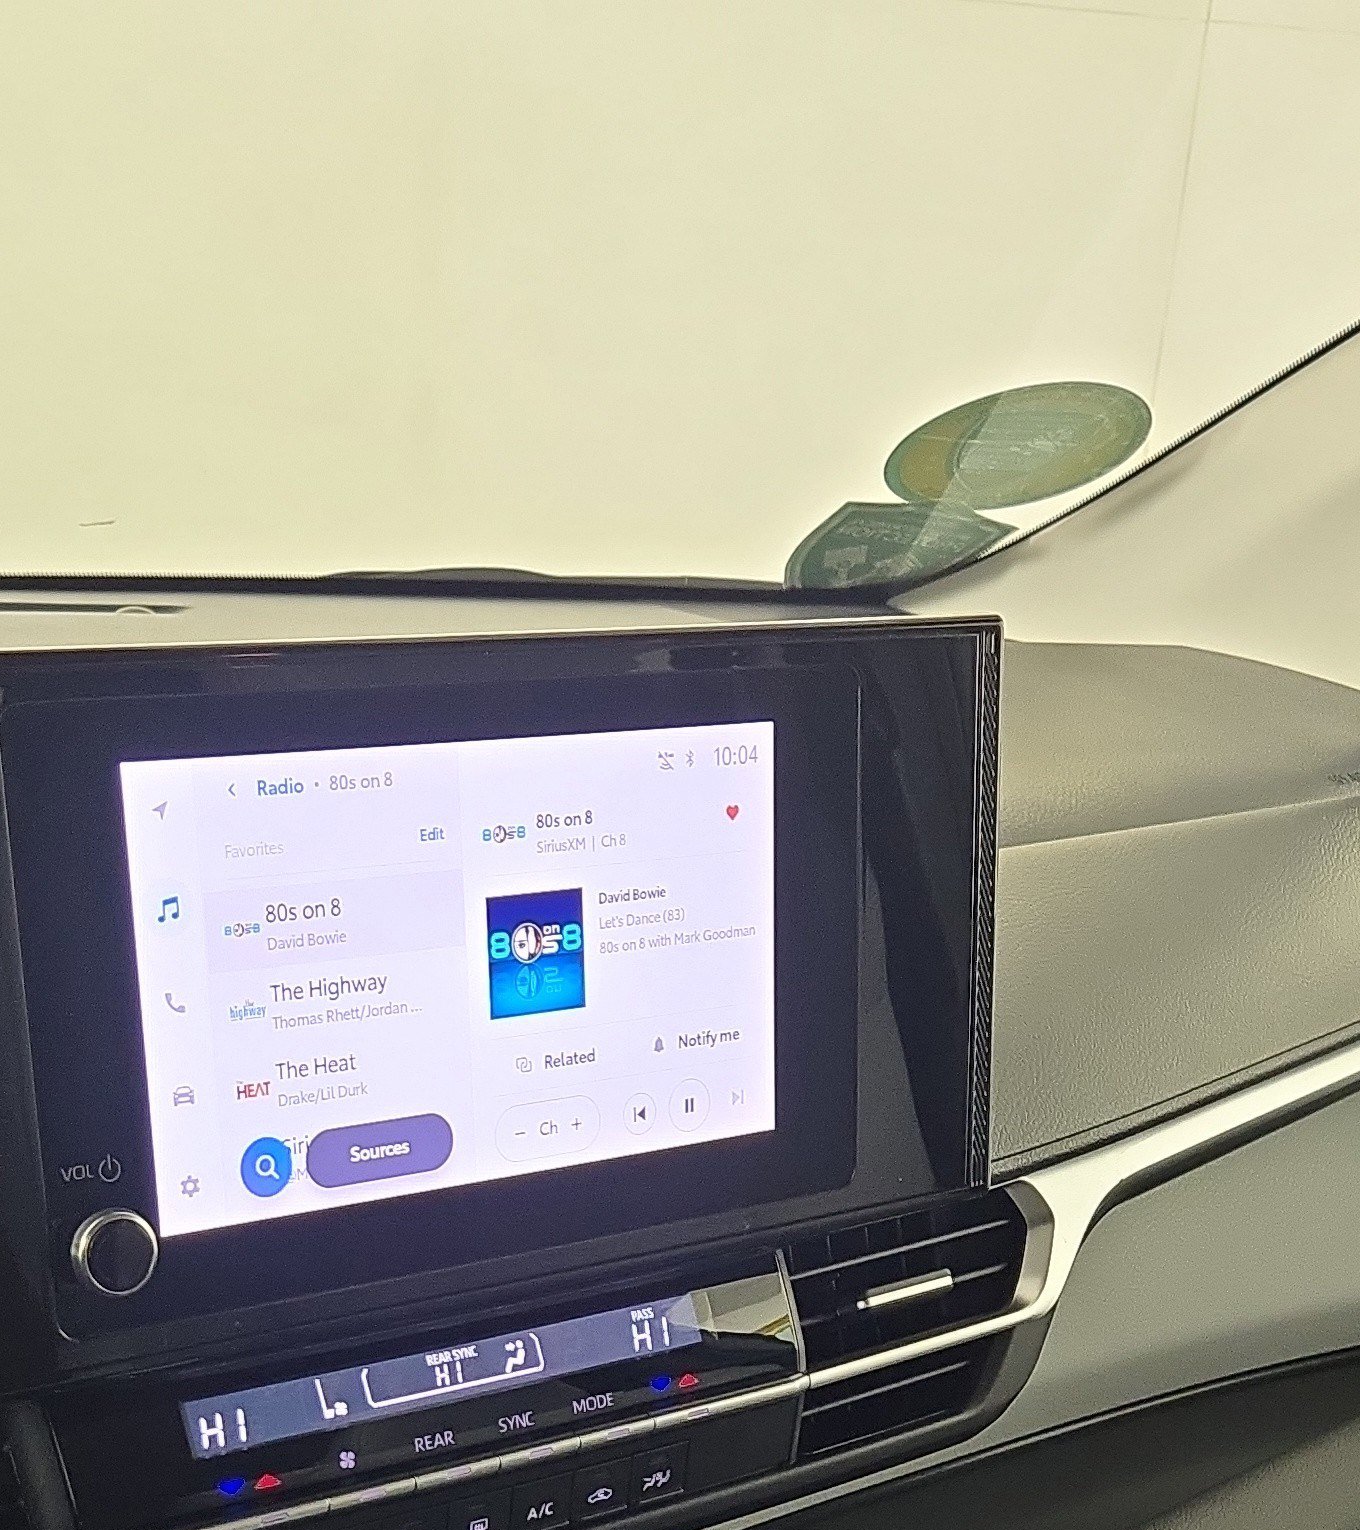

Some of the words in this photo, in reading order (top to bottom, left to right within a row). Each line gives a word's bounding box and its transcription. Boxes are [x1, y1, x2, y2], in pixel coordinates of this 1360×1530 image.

[714, 745, 758, 766] 10:04
[257, 778, 304, 797] Radio
[329, 775, 356, 791] 80s
[361, 776, 381, 789] on
[384, 772, 393, 787] 8
[536, 814, 560, 828] 80s
[564, 815, 581, 826] on
[585, 811, 593, 824] 8
[420, 827, 445, 842] Edit
[536, 837, 586, 853] SiriusXM
[601, 836, 617, 849] Ch
[619, 834, 626, 845] 8
[224, 842, 284, 859] Favorites
[598, 889, 630, 904] David
[633, 886, 666, 900] Bowie
[265, 903, 297, 923] 80s
[303, 902, 326, 919] on
[330, 898, 342, 917] 8
[599, 915, 624, 929] Let's
[626, 912, 661, 927] Dance
[663, 908, 685, 923] (83)
[267, 934, 304, 950] David
[307, 930, 347, 946] Bowie
[600, 941, 619, 954] 80s
[622, 940, 637, 951] on
[639, 937, 645, 949] 8
[648, 933, 672, 948] with
[674, 931, 700, 946] Mark
[703, 925, 756, 941] Goodman
[270, 983, 304, 1002] The
[309, 974, 387, 1000] Highway
[272, 1014, 323, 1029] Thomas
[326, 1002, 408, 1023] Rhett/Jordan
[678, 1030, 717, 1050] Notify
[720, 1029, 740, 1043] me
[275, 1061, 308, 1079] The
[314, 1054, 356, 1075] Heat
[544, 1048, 596, 1069] Related
[237, 1081, 270, 1100] HEAT
[278, 1086, 336, 1107] Drake/Lil
[338, 1082, 368, 1098] Durk
[540, 1120, 558, 1136] Ch
[349, 1142, 410, 1163] Sources
[61, 1165, 93, 1182] VOL
[631, 1307, 654, 1322] PASS
[632, 1315, 670, 1352] HI
[425, 1350, 452, 1367] REAR
[452, 1345, 478, 1361] SYNC
[435, 1361, 463, 1386] HI
[572, 1393, 614, 1415] MODE
[199, 1408, 247, 1450] HI
[498, 1411, 535, 1434] SYNC
[414, 1431, 456, 1453] REAR
[527, 1502, 554, 1521] A/C
